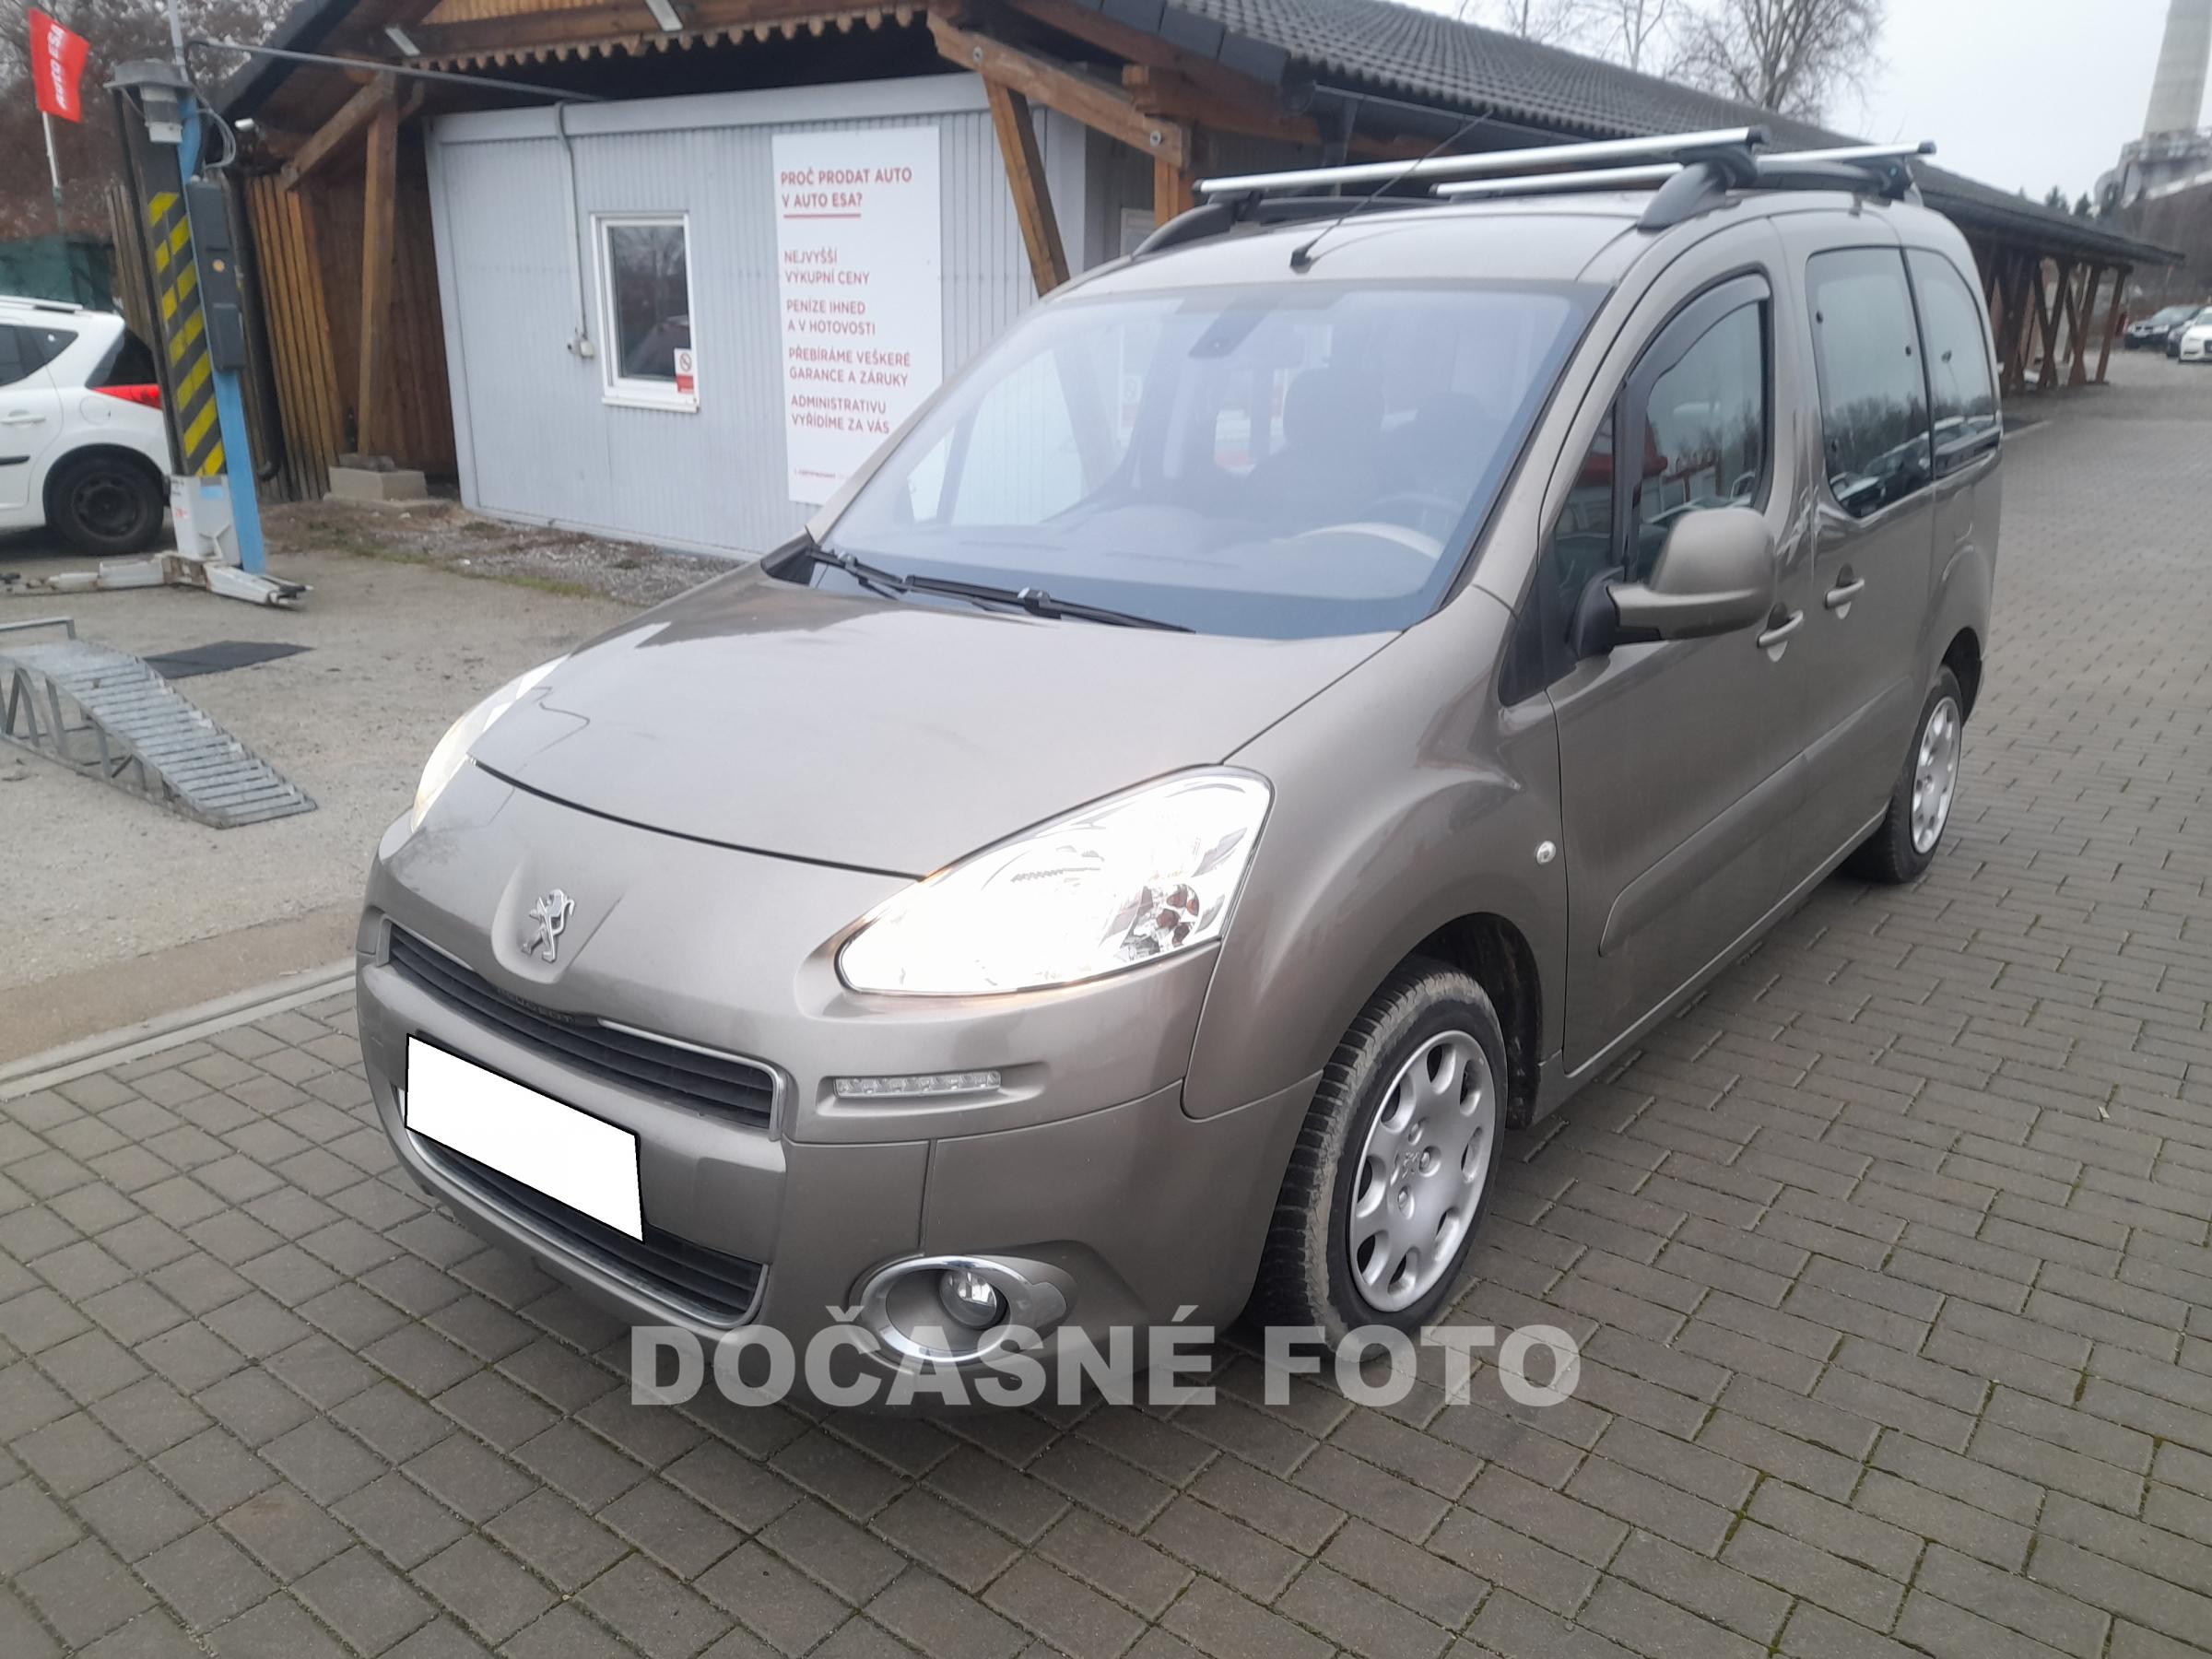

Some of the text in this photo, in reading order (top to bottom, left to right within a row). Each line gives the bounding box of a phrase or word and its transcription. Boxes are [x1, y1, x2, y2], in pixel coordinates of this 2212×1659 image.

[781, 167, 912, 185] PROČ PRODAT AUTO
[782, 192, 863, 207] V AUTO ESA?
[784, 247, 838, 264] NEJVYŠŠÍ
[785, 267, 870, 285] VÝKUPNÍ CENY
[786, 298, 865, 314] PENÍZE IHNED
[787, 319, 876, 335] A V HOTOVOSTI
[789, 345, 911, 367] PŘEBÍRÁME VEŠKERÉ
[789, 366, 908, 387] GARANCE A ZÁRUKY
[791, 394, 886, 415] ADMINISTRATIVU
[791, 411, 890, 434] VYŘÍDÍME ZA VÁS
